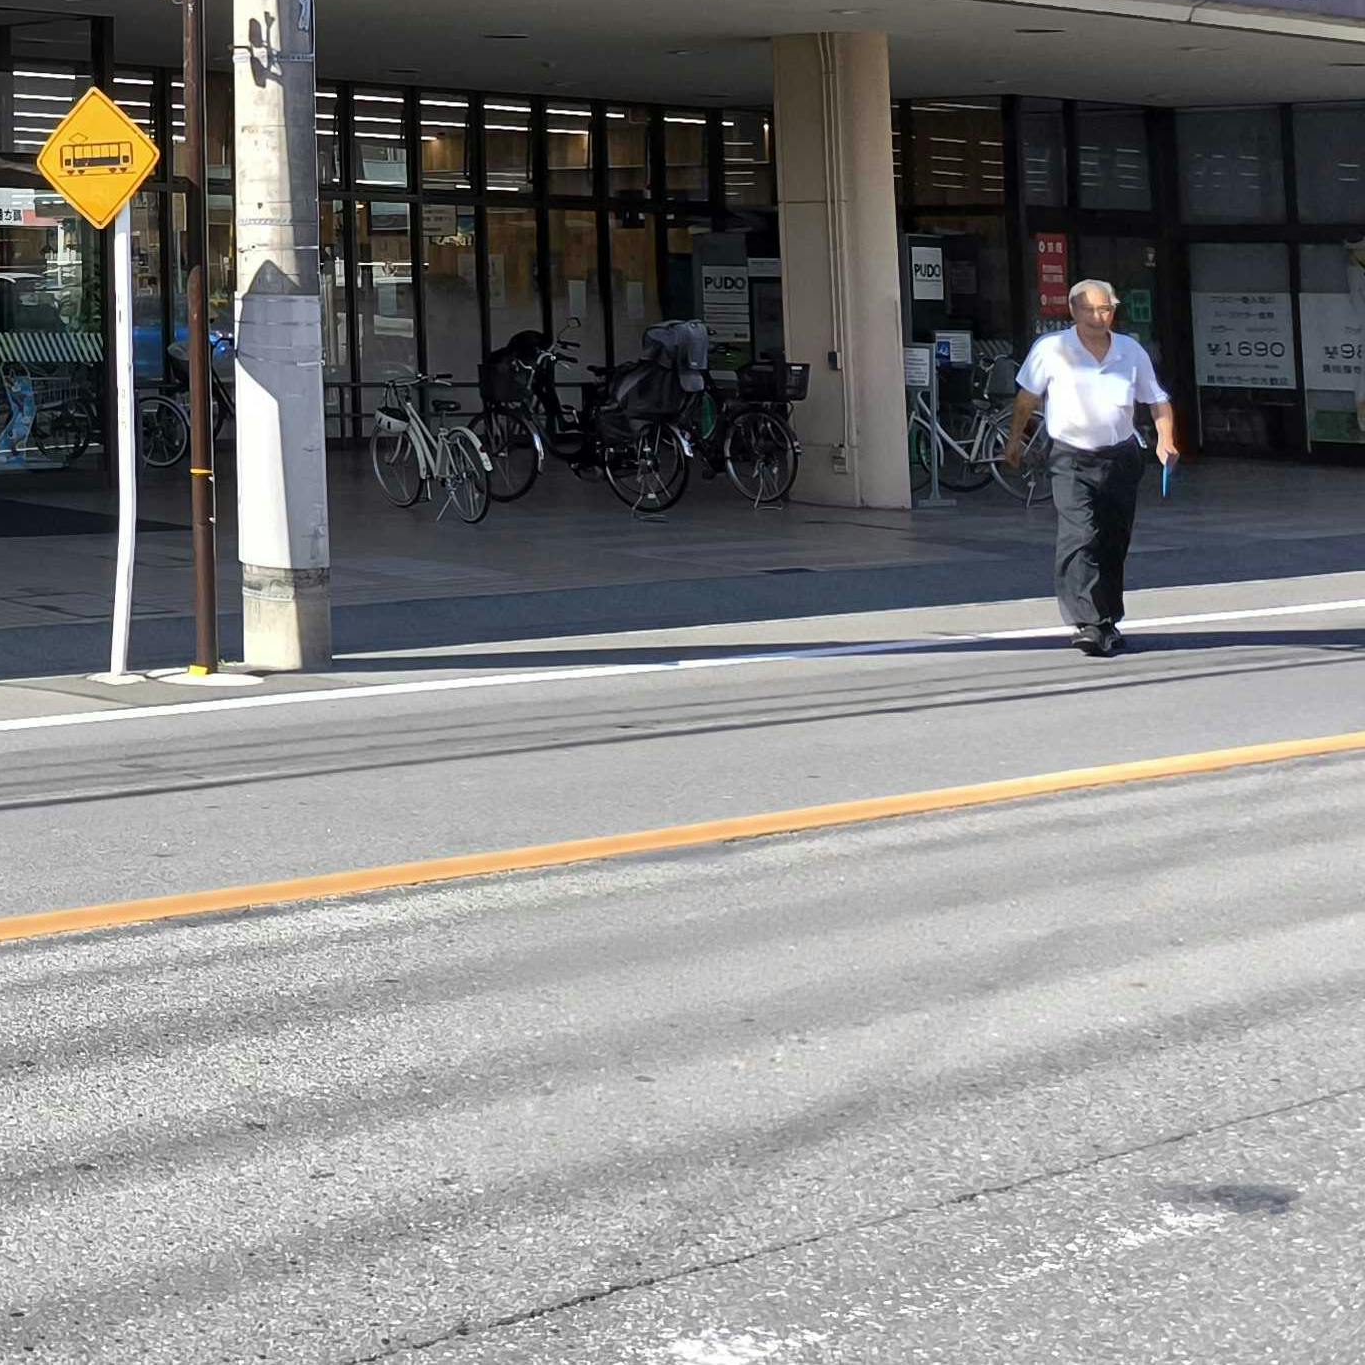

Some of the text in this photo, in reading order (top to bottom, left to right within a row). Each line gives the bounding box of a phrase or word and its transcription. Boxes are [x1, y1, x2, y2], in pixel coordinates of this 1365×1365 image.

[914, 263, 941, 278] PUDO
[704, 276, 746, 290] PUDO
[1207, 341, 1286, 357] ¥1690
